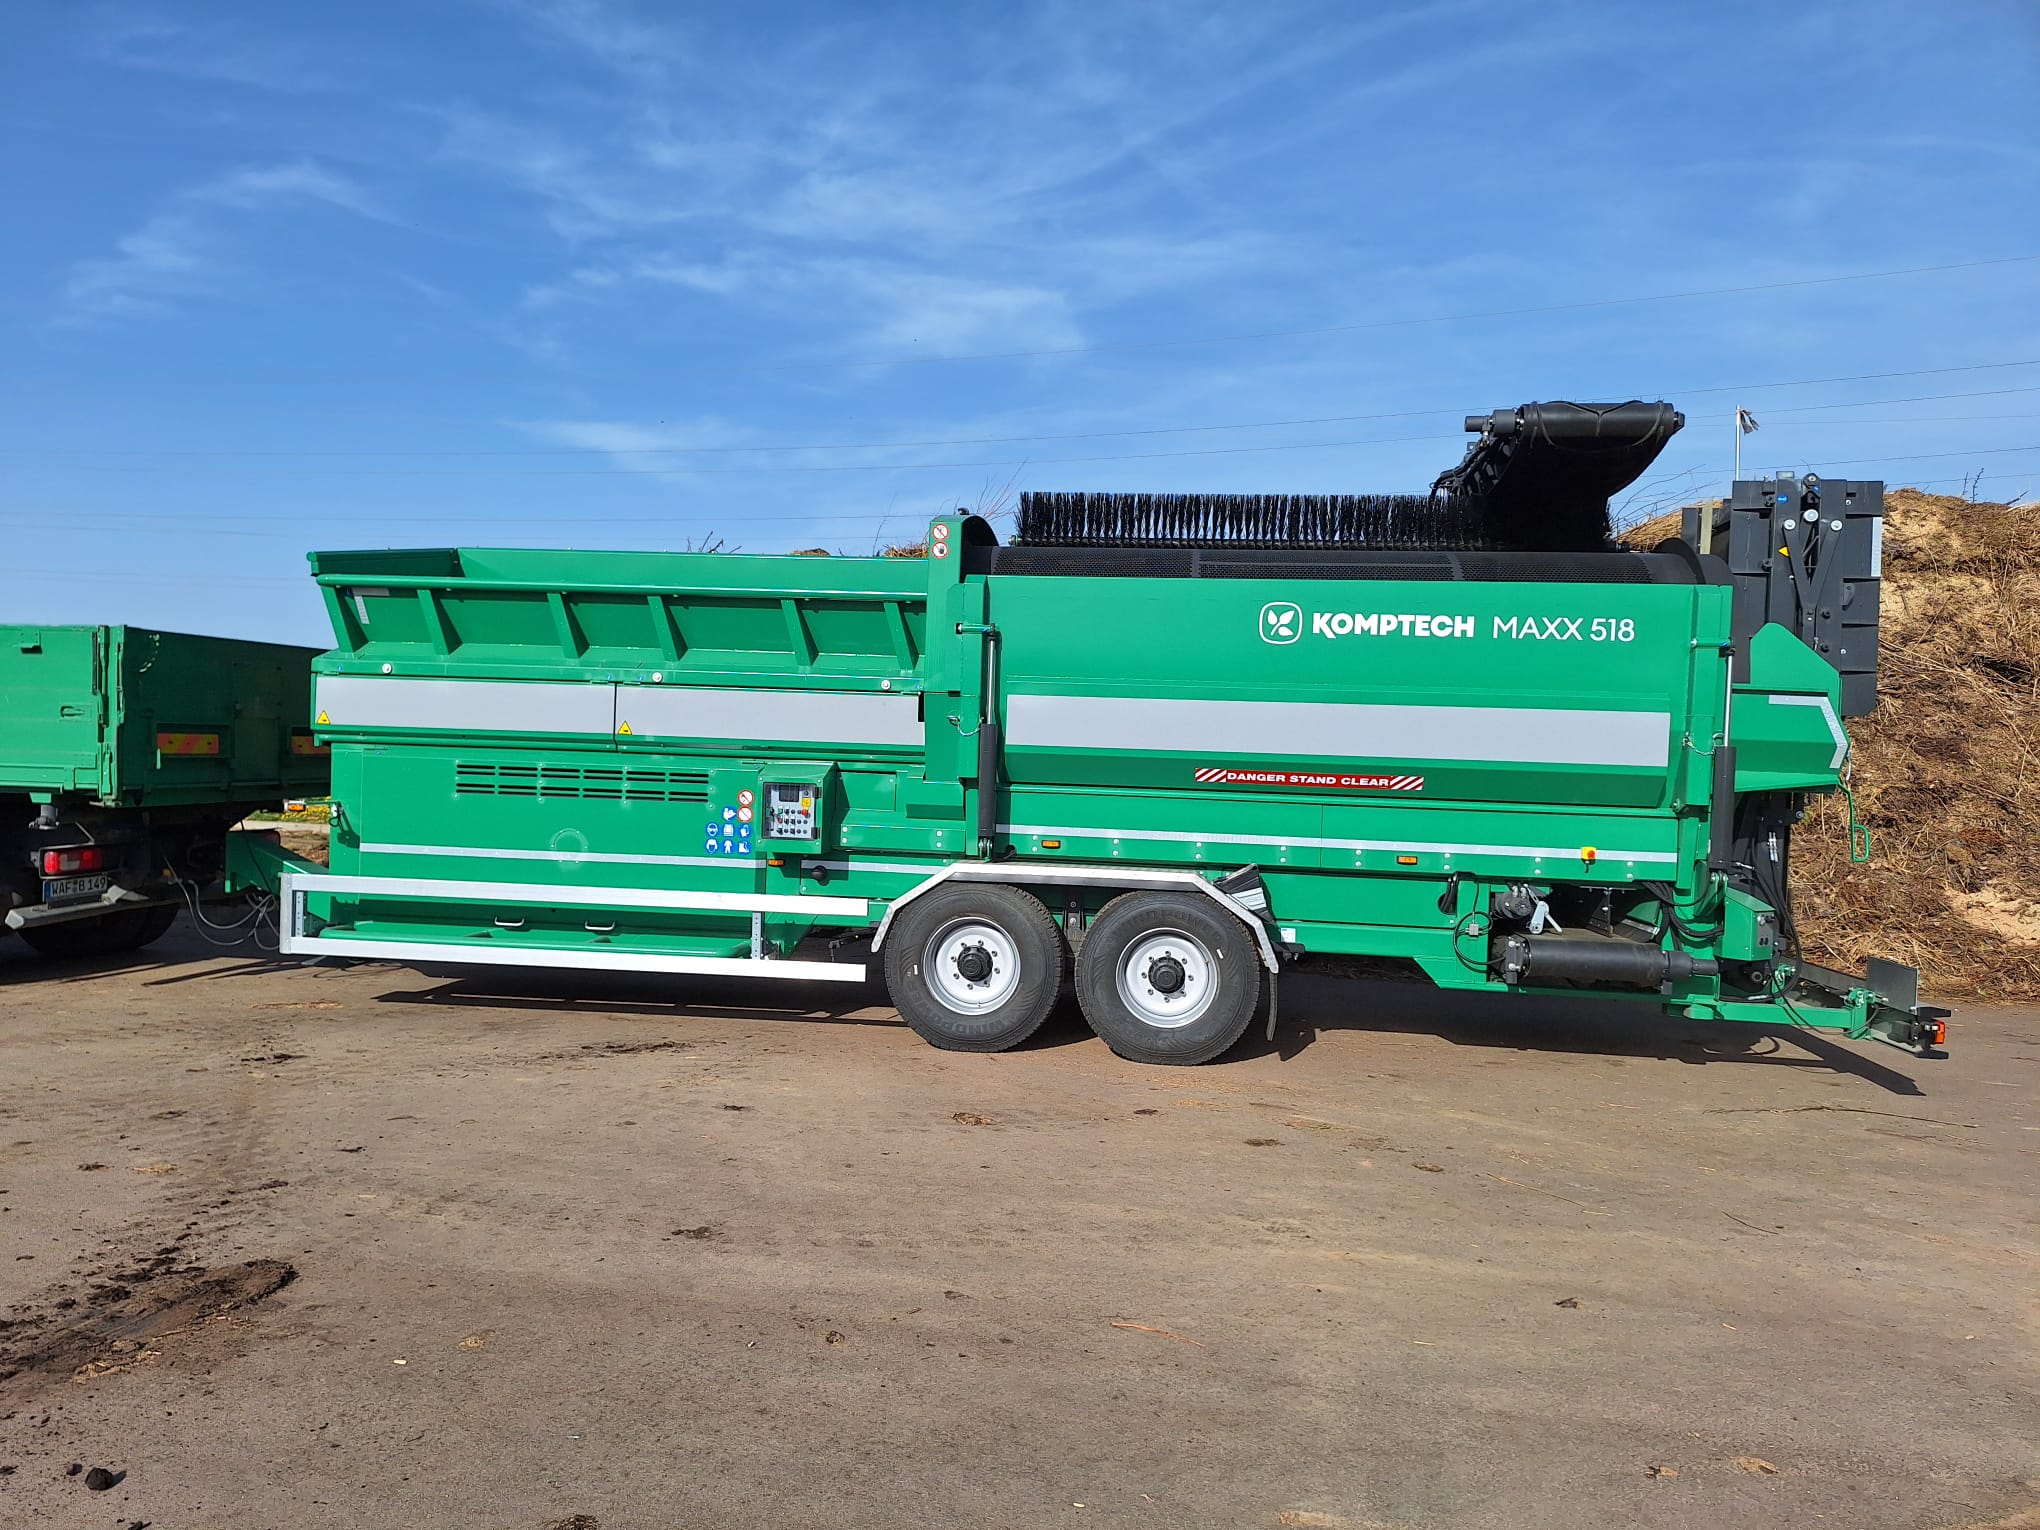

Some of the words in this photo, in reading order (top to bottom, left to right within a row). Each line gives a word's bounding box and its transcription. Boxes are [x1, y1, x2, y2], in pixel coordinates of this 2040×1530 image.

[1312, 612, 1475, 639] KOMPTECH
[1492, 615, 1584, 641] MAXX
[1589, 617, 1636, 642] 518
[1227, 771, 1286, 783] DANGER
[1289, 774, 1337, 785] STAND
[1340, 776, 1389, 787] CLEAR
[52, 879, 72, 897] WAF
[78, 879, 86, 892] B
[87, 876, 107, 891] 149
